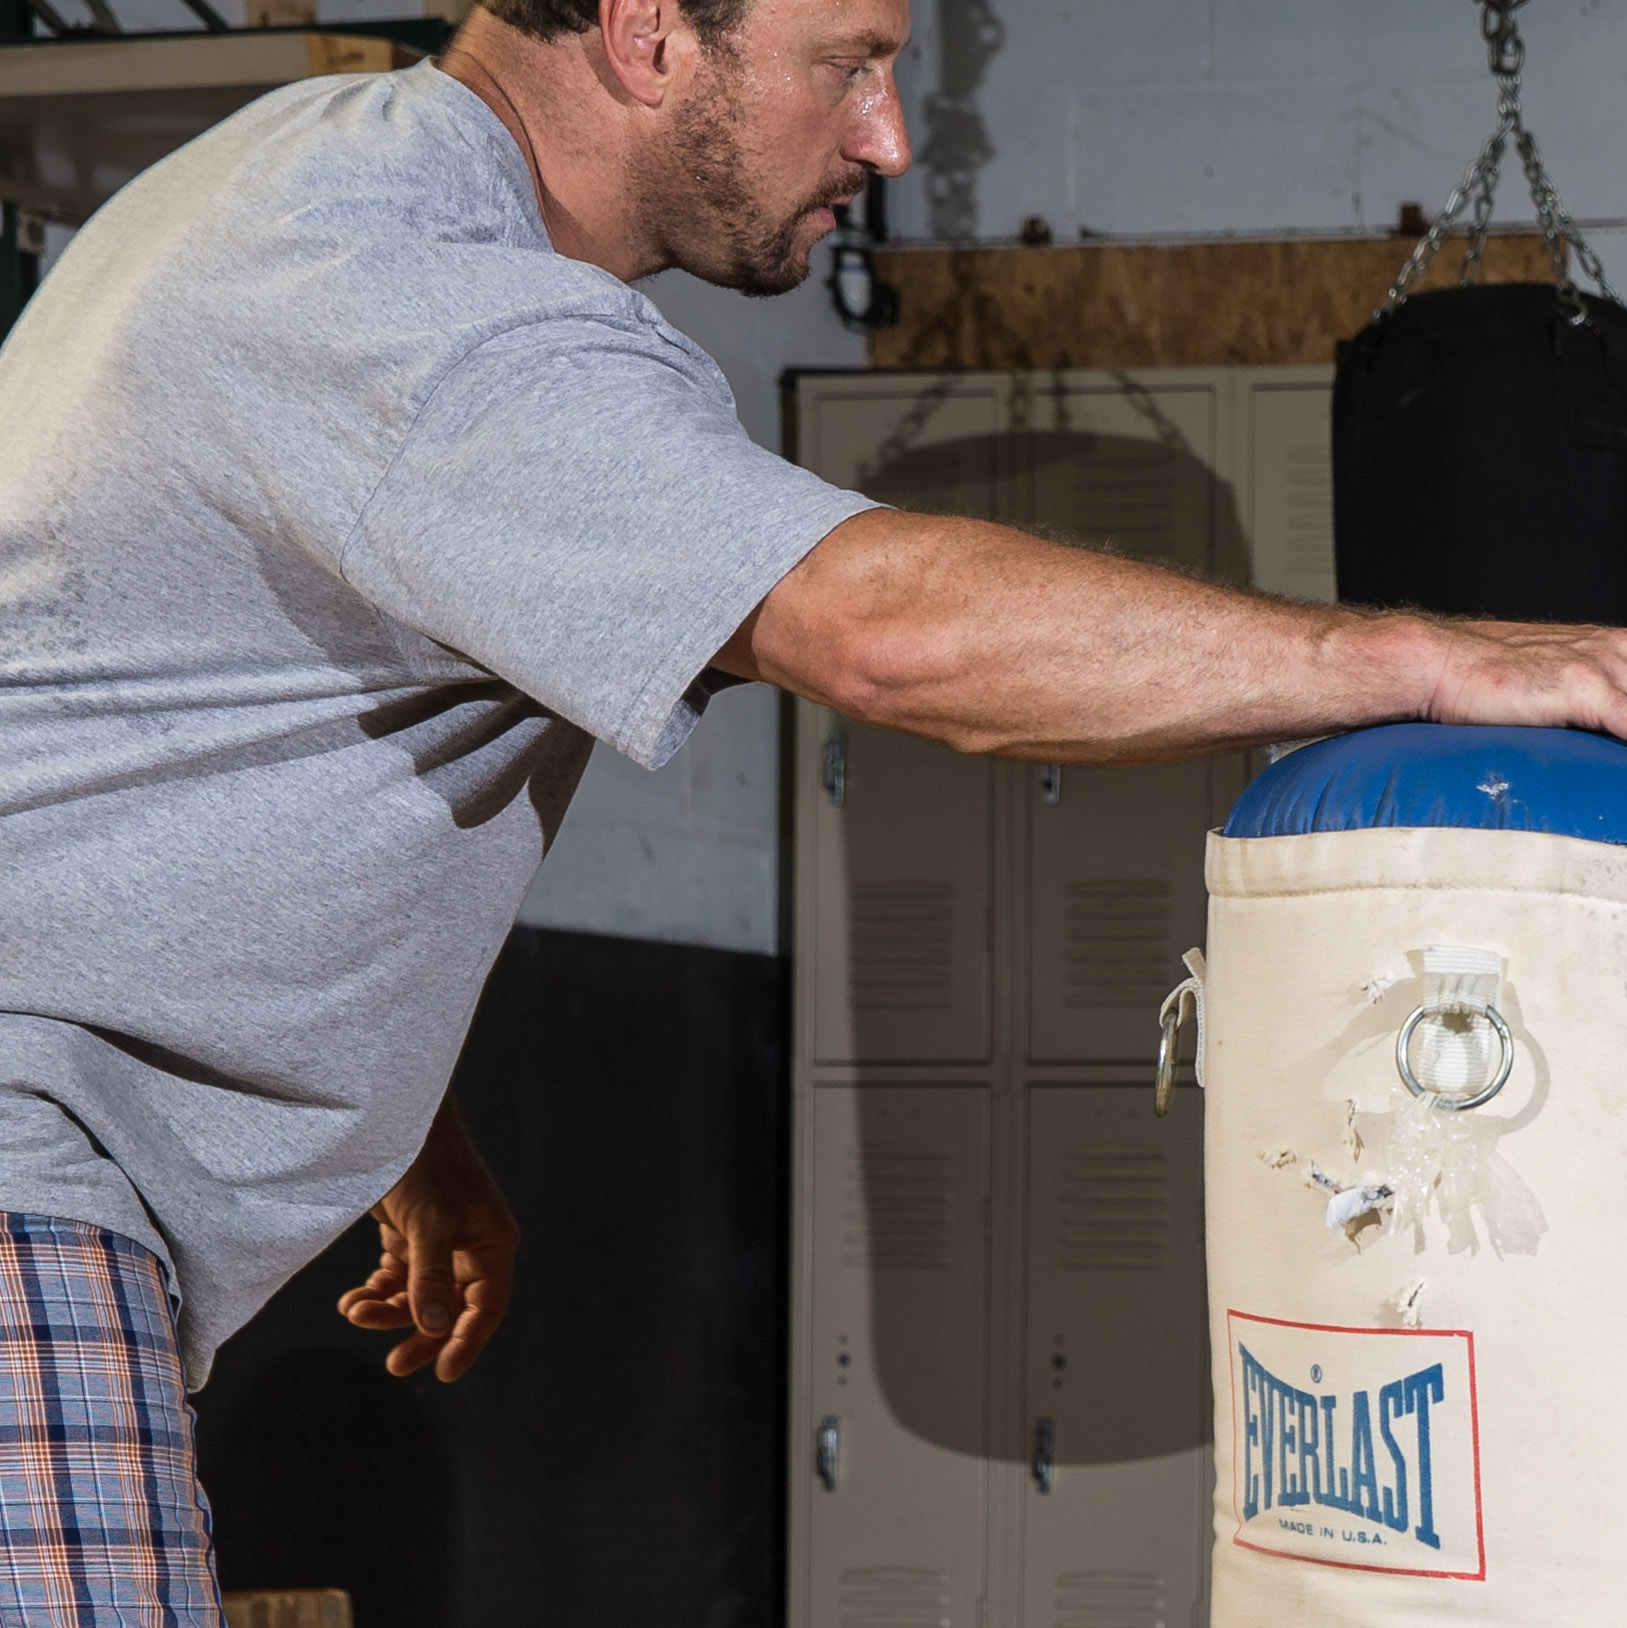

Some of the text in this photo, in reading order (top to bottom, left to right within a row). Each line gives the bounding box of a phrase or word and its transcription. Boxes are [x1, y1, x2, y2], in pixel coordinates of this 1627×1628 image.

[1238, 1340, 1445, 1550] EVERLAST
[1278, 1518, 1388, 1545] MADE IN U.S.A.
